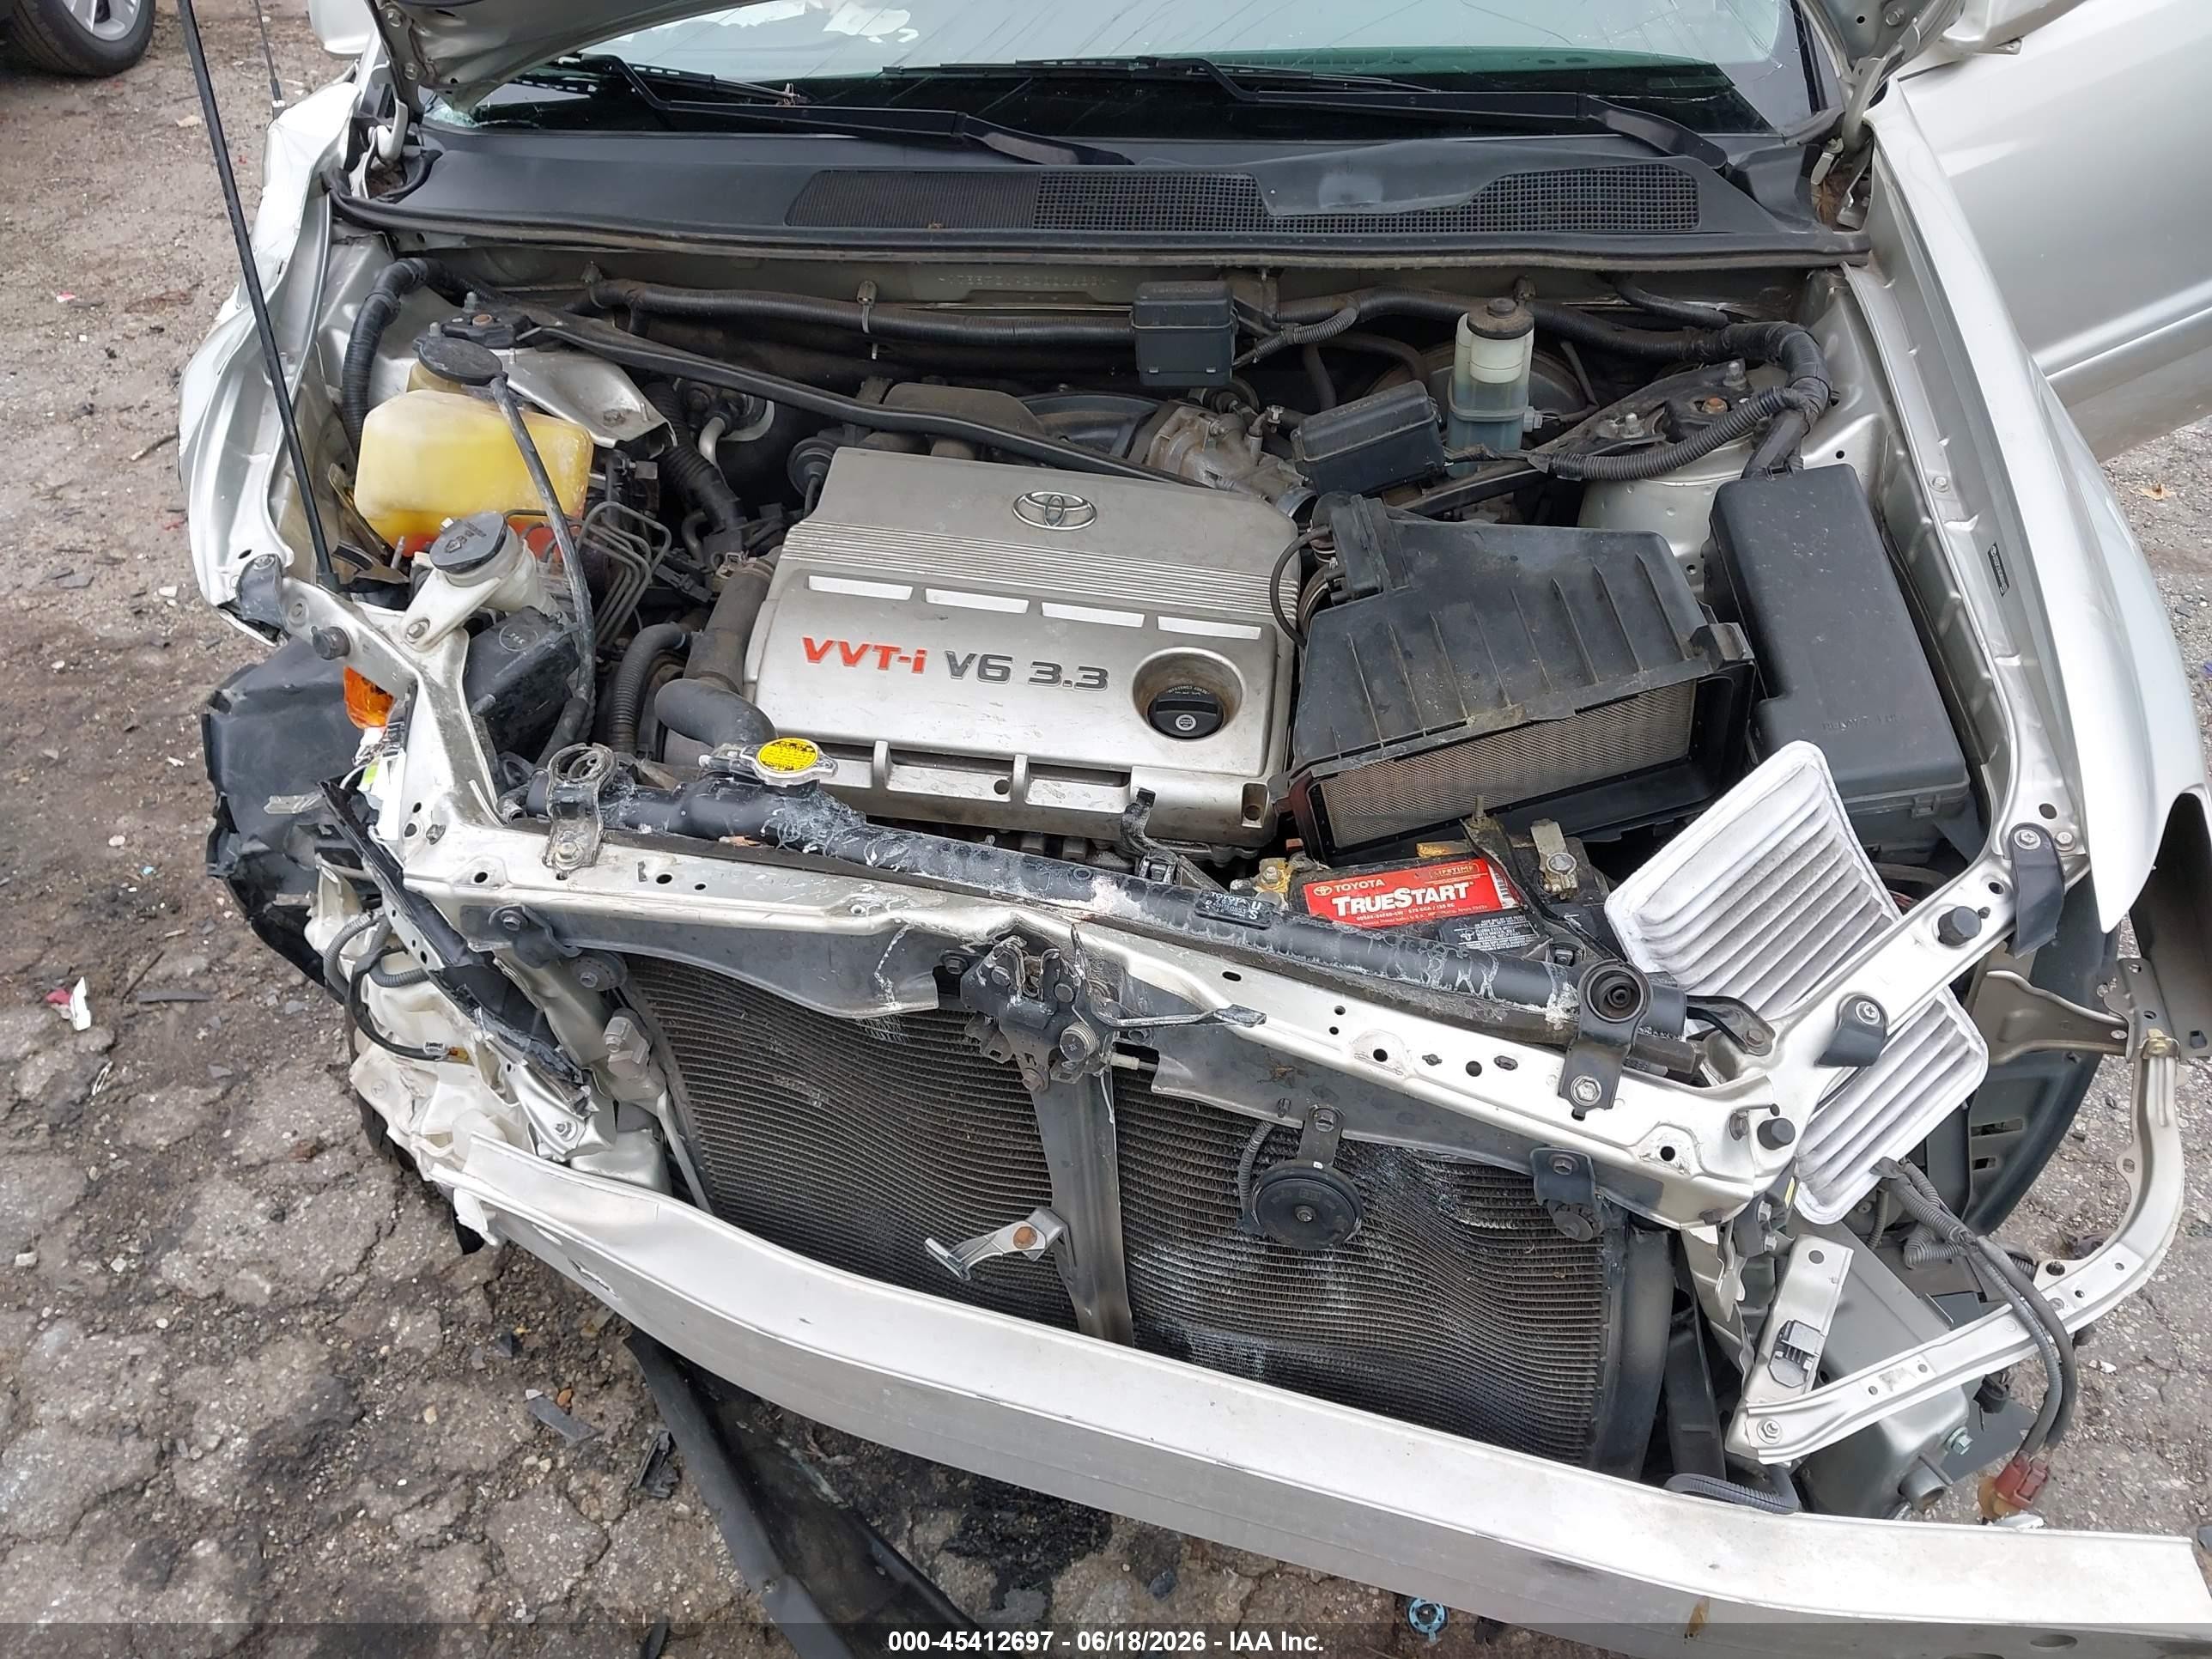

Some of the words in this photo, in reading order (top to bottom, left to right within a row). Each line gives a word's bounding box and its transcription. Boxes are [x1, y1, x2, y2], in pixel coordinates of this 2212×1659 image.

[802, 636, 927, 674] VVT-i
[945, 650, 1014, 684] V6
[1028, 660, 1109, 692] 3.3
[1334, 878, 1385, 893] TOYOTA
[1211, 891, 1247, 904] TOYOTA
